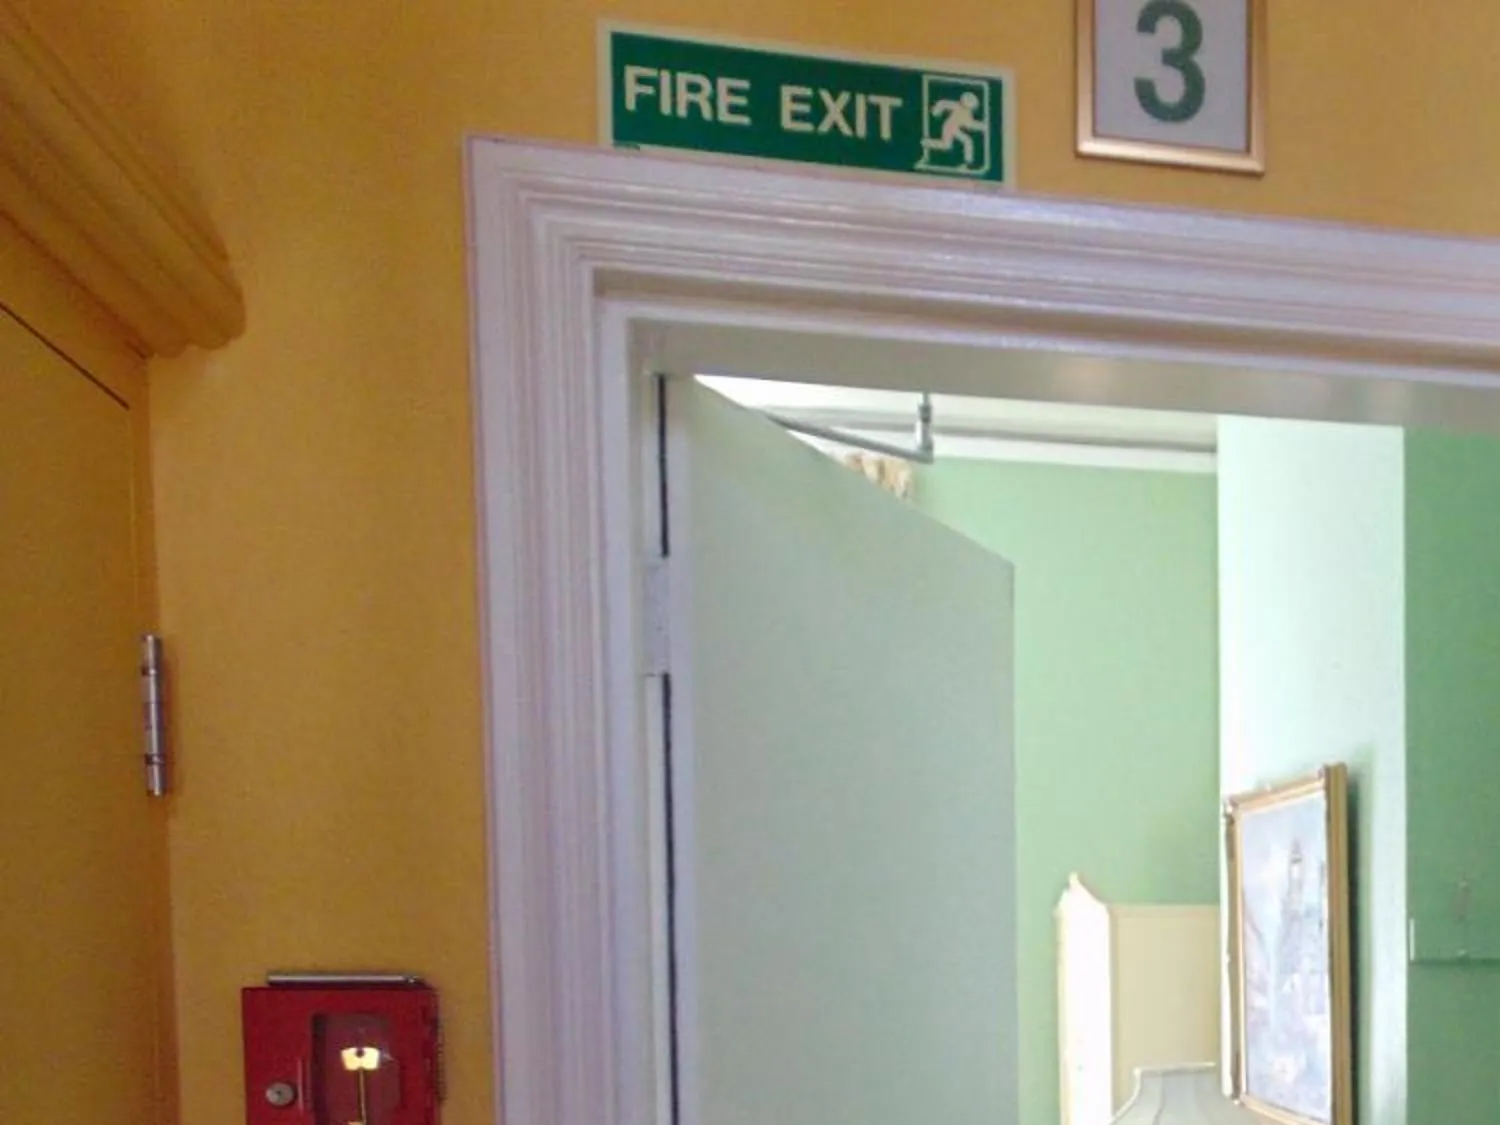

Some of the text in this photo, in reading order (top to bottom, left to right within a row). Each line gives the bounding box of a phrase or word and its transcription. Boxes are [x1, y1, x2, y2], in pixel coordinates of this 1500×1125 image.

[624, 64, 903, 142] FIRE EXIT
[1134, 0, 1206, 124] 3
